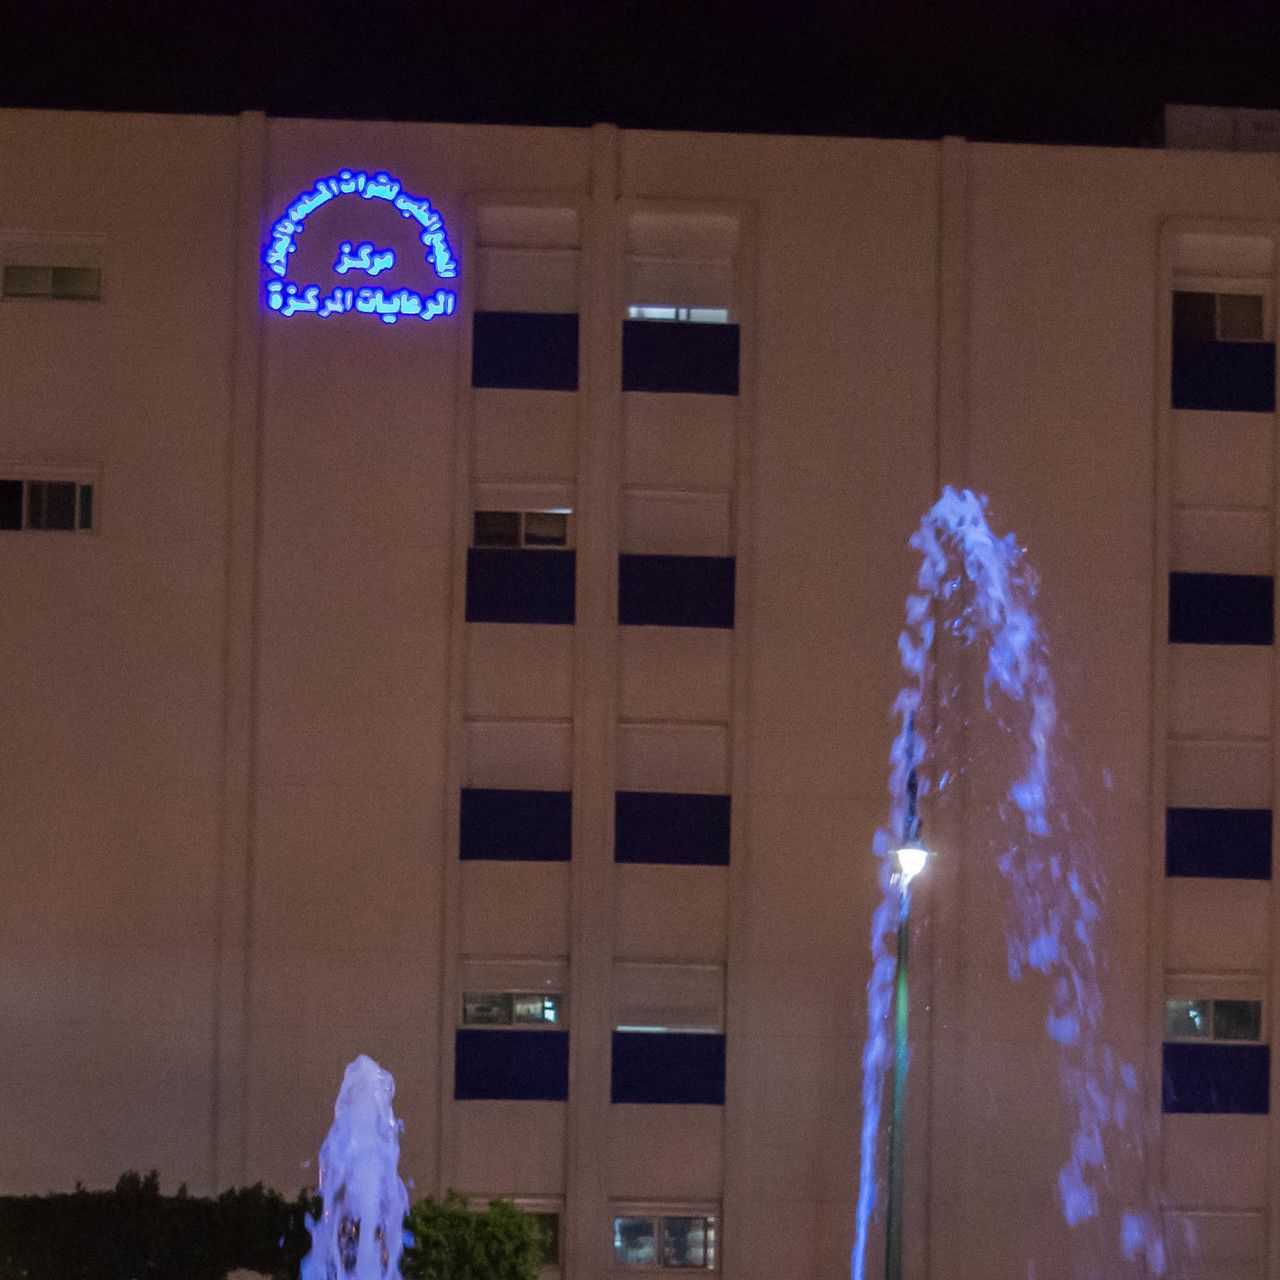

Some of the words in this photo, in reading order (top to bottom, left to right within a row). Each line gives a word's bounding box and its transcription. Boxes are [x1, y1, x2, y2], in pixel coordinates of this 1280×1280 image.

[339, 171, 399, 200] للقوات
[334, 242, 394, 275] مركز
[266, 279, 354, 317] المركزة
[356, 287, 455, 323] الرعايات
